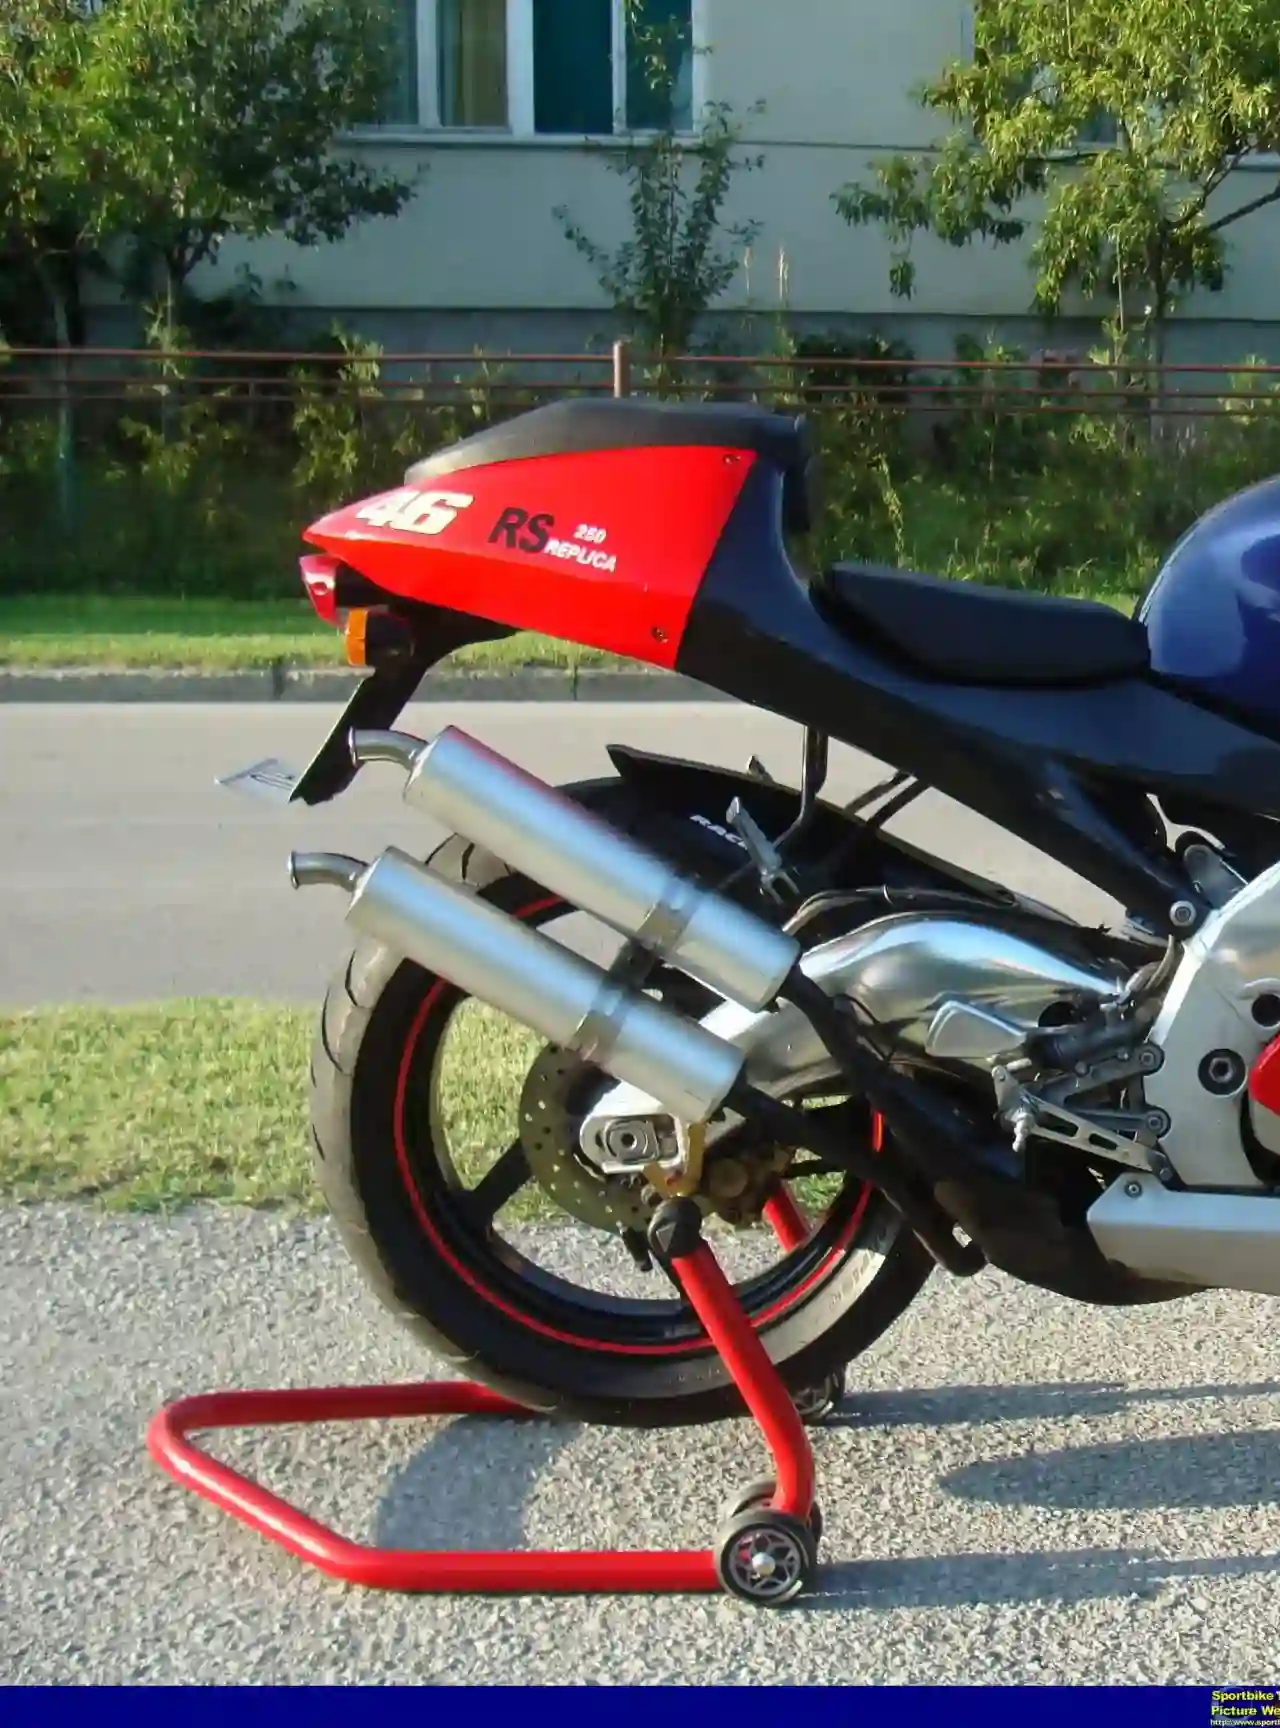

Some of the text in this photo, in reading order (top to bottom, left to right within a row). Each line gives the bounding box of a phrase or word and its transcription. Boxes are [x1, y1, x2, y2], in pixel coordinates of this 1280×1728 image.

[355, 490, 474, 535] 46
[487, 506, 555, 553] RS
[573, 523, 607, 543] 250
[543, 536, 617, 574] REPLICA
